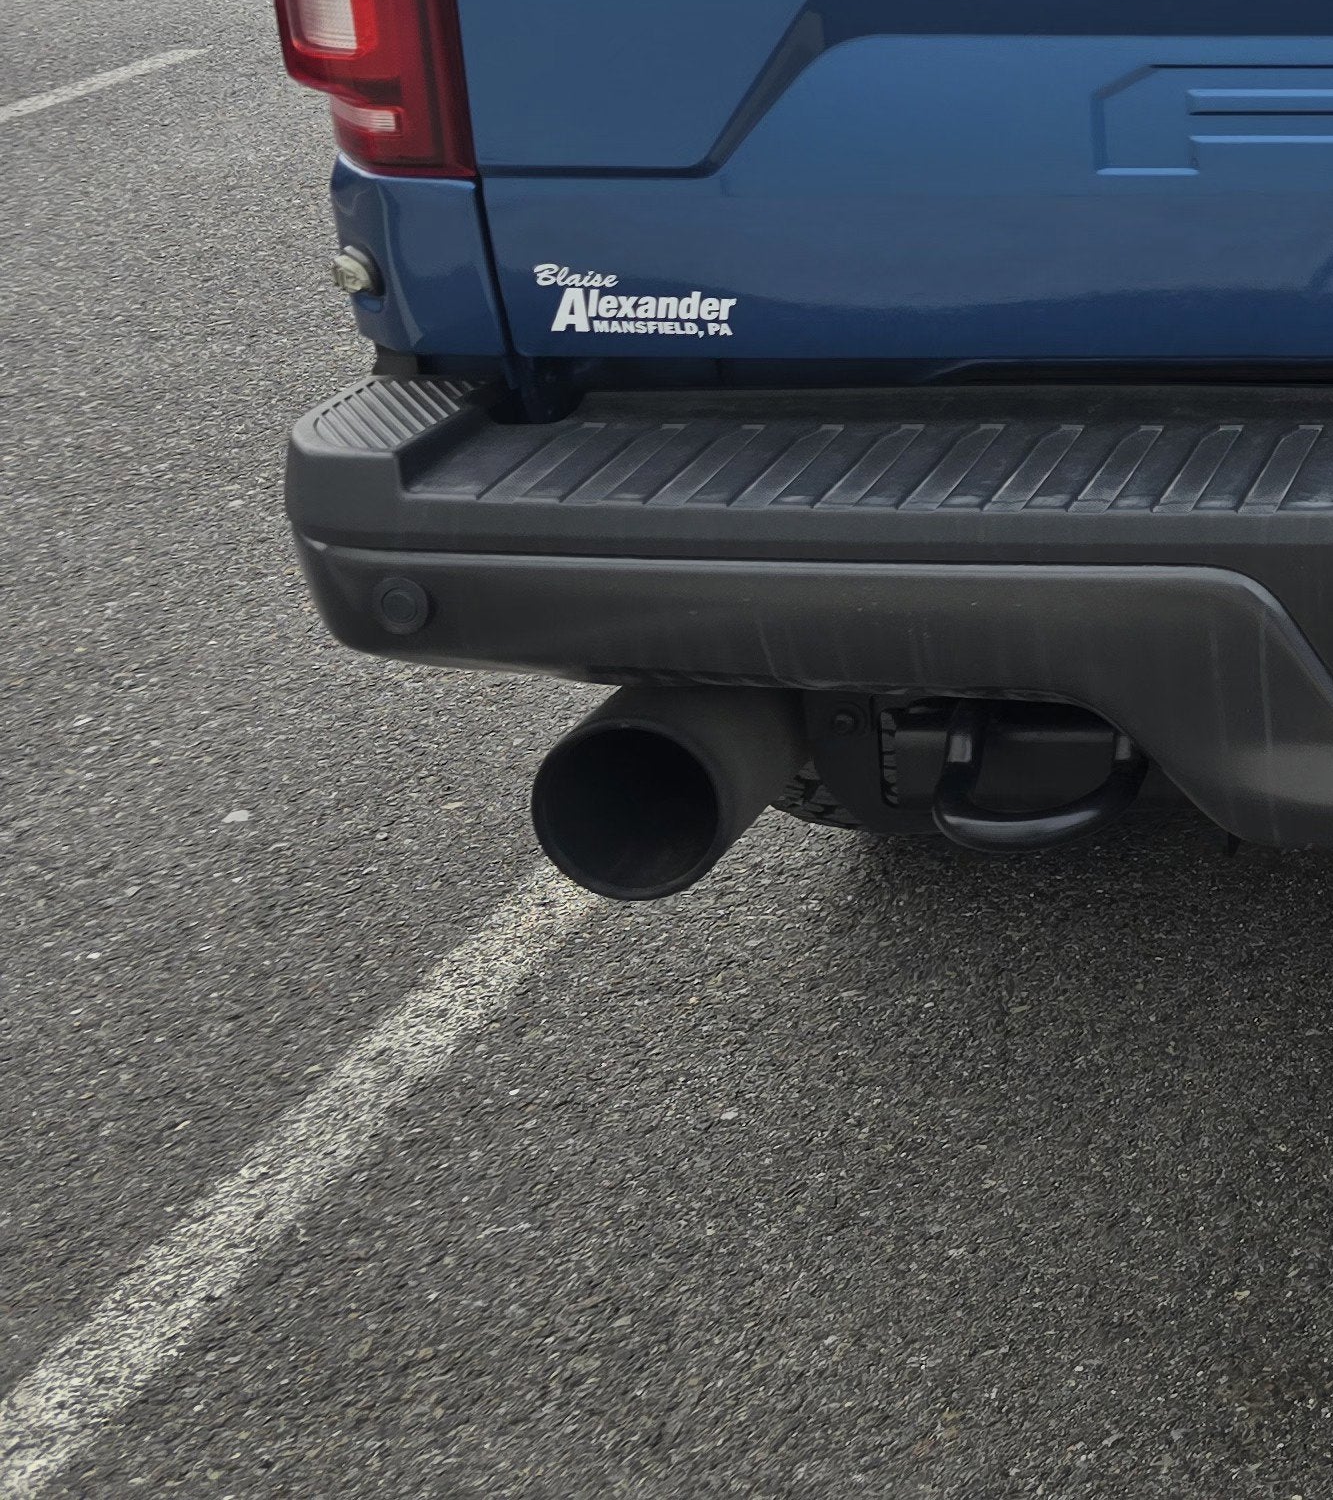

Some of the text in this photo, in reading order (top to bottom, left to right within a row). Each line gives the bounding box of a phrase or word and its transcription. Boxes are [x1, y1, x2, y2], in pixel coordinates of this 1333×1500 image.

[533, 263, 619, 288] Blaise
[551, 287, 737, 333] Alexander
[592, 320, 733, 339] MANSFIELD, PA
